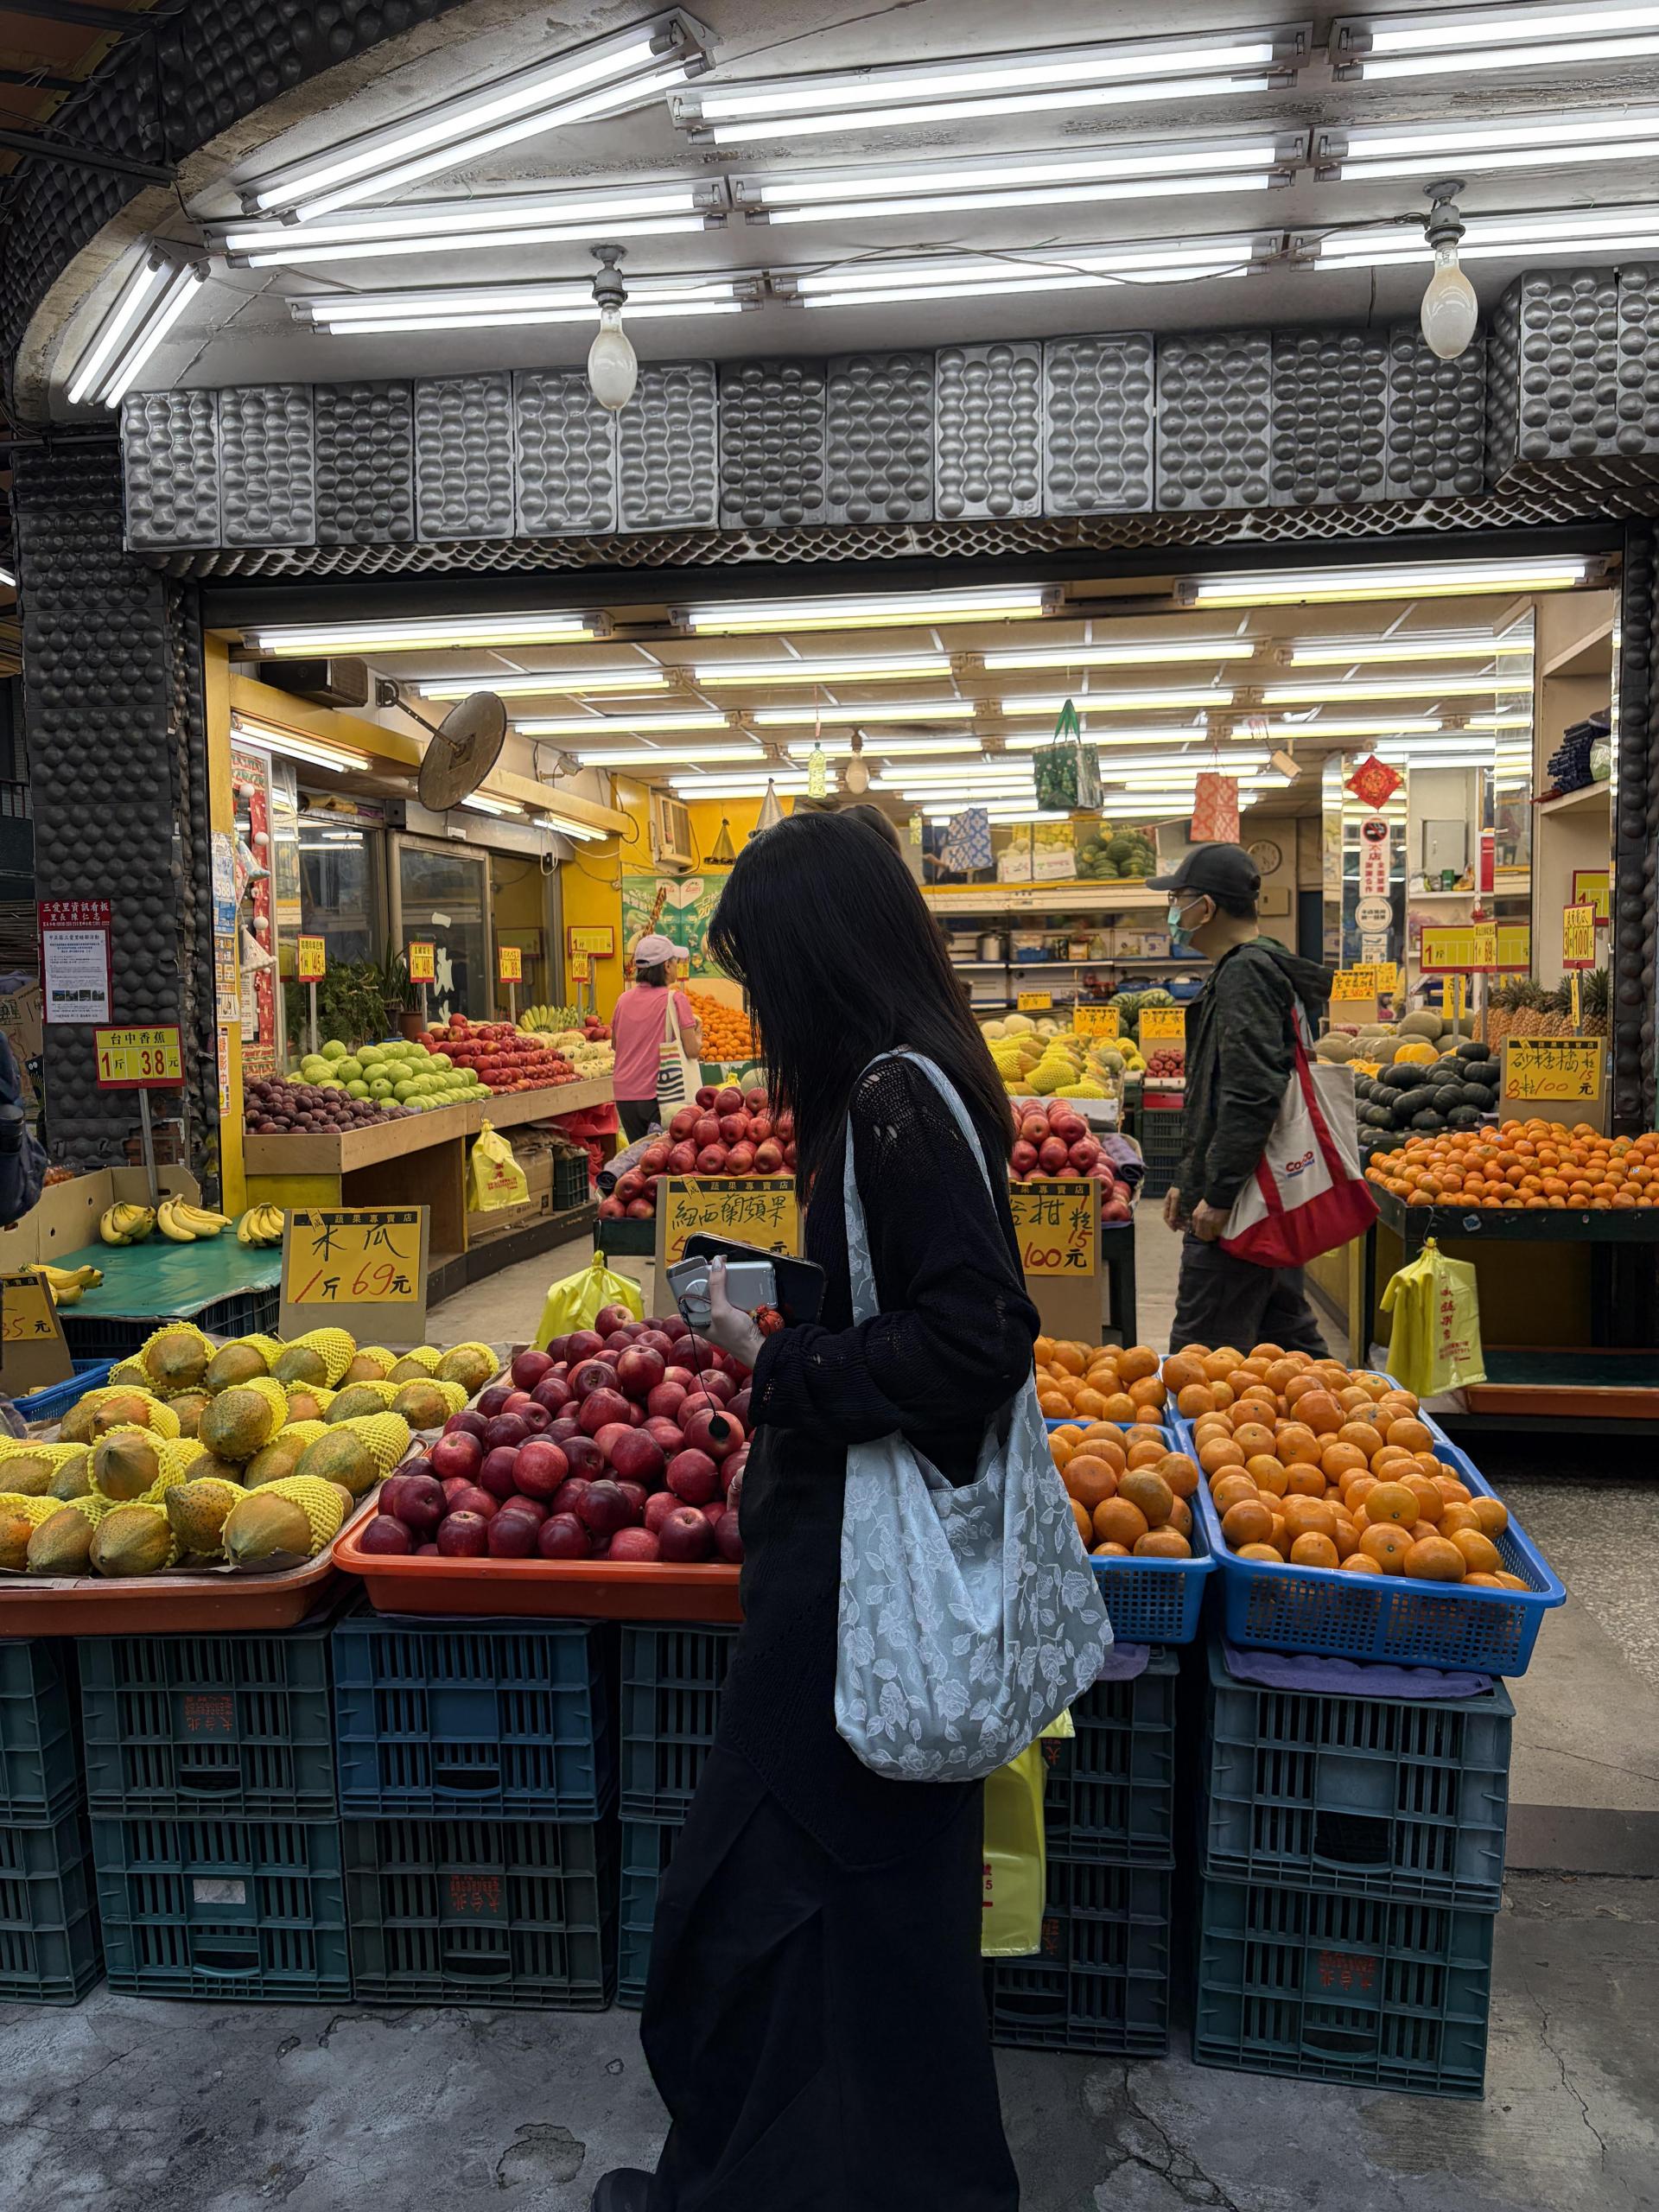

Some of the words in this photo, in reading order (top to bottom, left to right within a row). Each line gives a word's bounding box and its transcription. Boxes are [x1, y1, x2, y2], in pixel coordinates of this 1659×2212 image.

[43, 901, 109, 912] 三愛里資訊看板
[111, 1031, 165, 1046] 台中香蕉
[710, 1181, 788, 1191] 蔬果專賣店
[1009, 1185, 1084, 1194] 果專賣店
[672, 1193, 785, 1230] 紐西蘭蘋果
[334, 1213, 412, 1224] 蔬果專賣店
[312, 1224, 410, 1262] 木瓜
[1024, 1243, 1087, 1268] 100元
